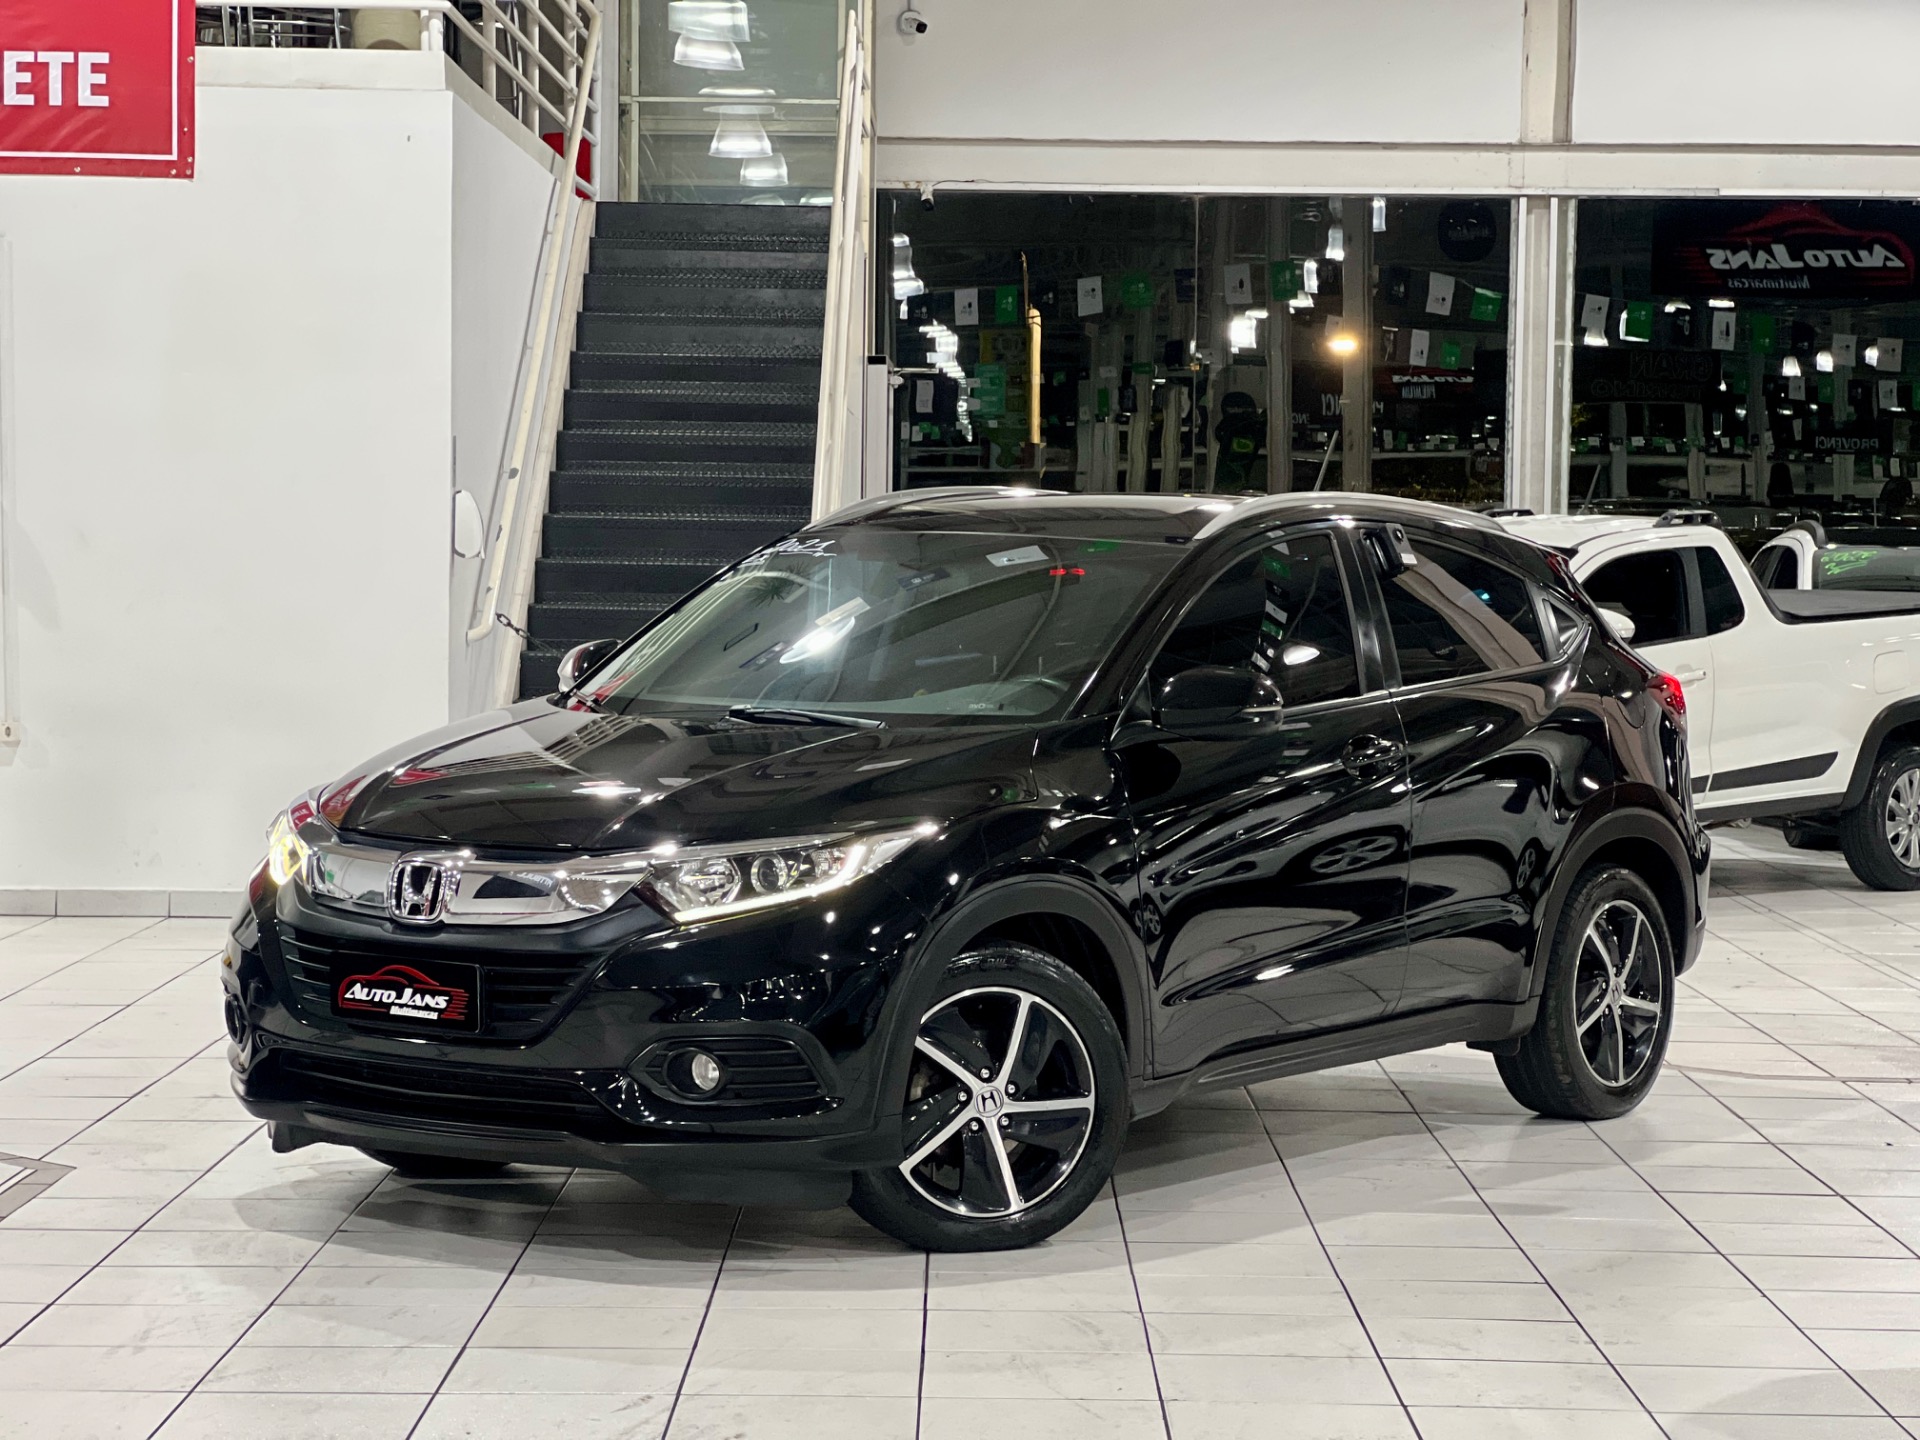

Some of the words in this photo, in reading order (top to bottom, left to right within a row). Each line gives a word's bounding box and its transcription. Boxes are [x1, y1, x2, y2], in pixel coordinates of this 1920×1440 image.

[3, 51, 110, 106] ETE
[344, 982, 396, 1003] AUTO
[394, 988, 450, 1009] JANS
